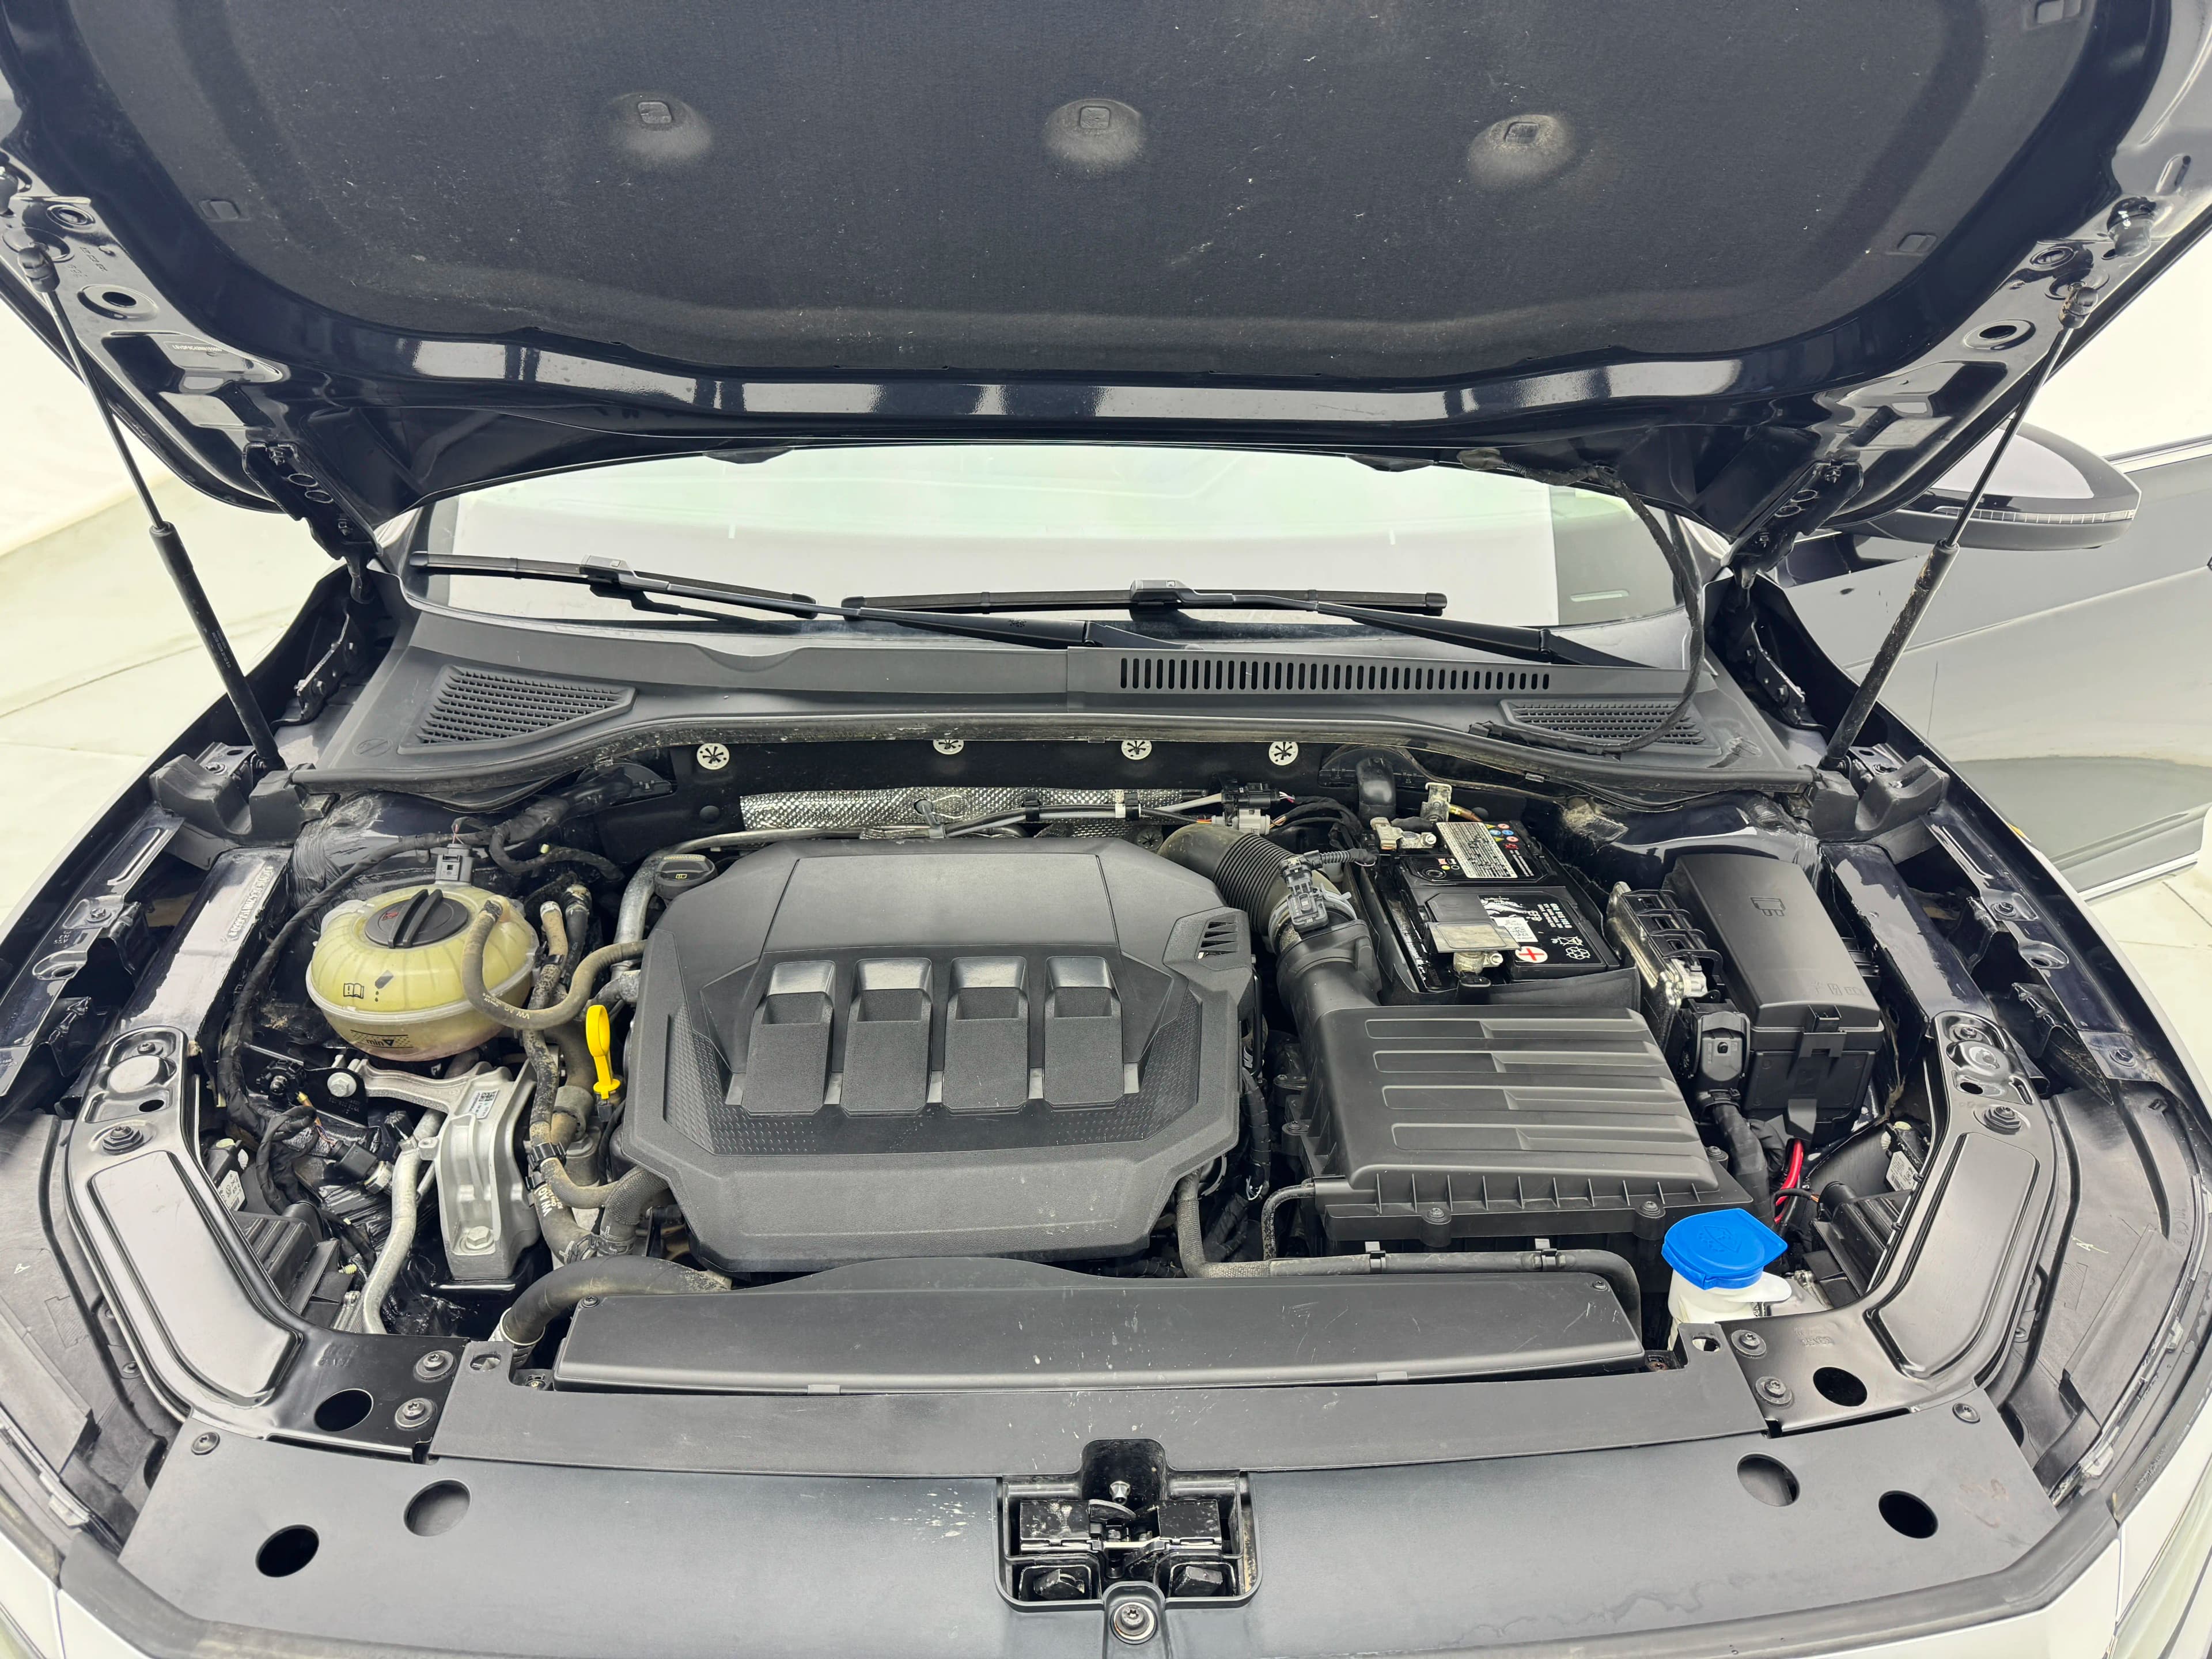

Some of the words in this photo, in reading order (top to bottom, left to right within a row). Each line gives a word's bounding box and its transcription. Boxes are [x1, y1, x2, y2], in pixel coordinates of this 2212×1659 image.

[516, 1010, 530, 1020] VW
[539, 1187, 550, 1201] AG
[541, 1200, 552, 1217] VW
